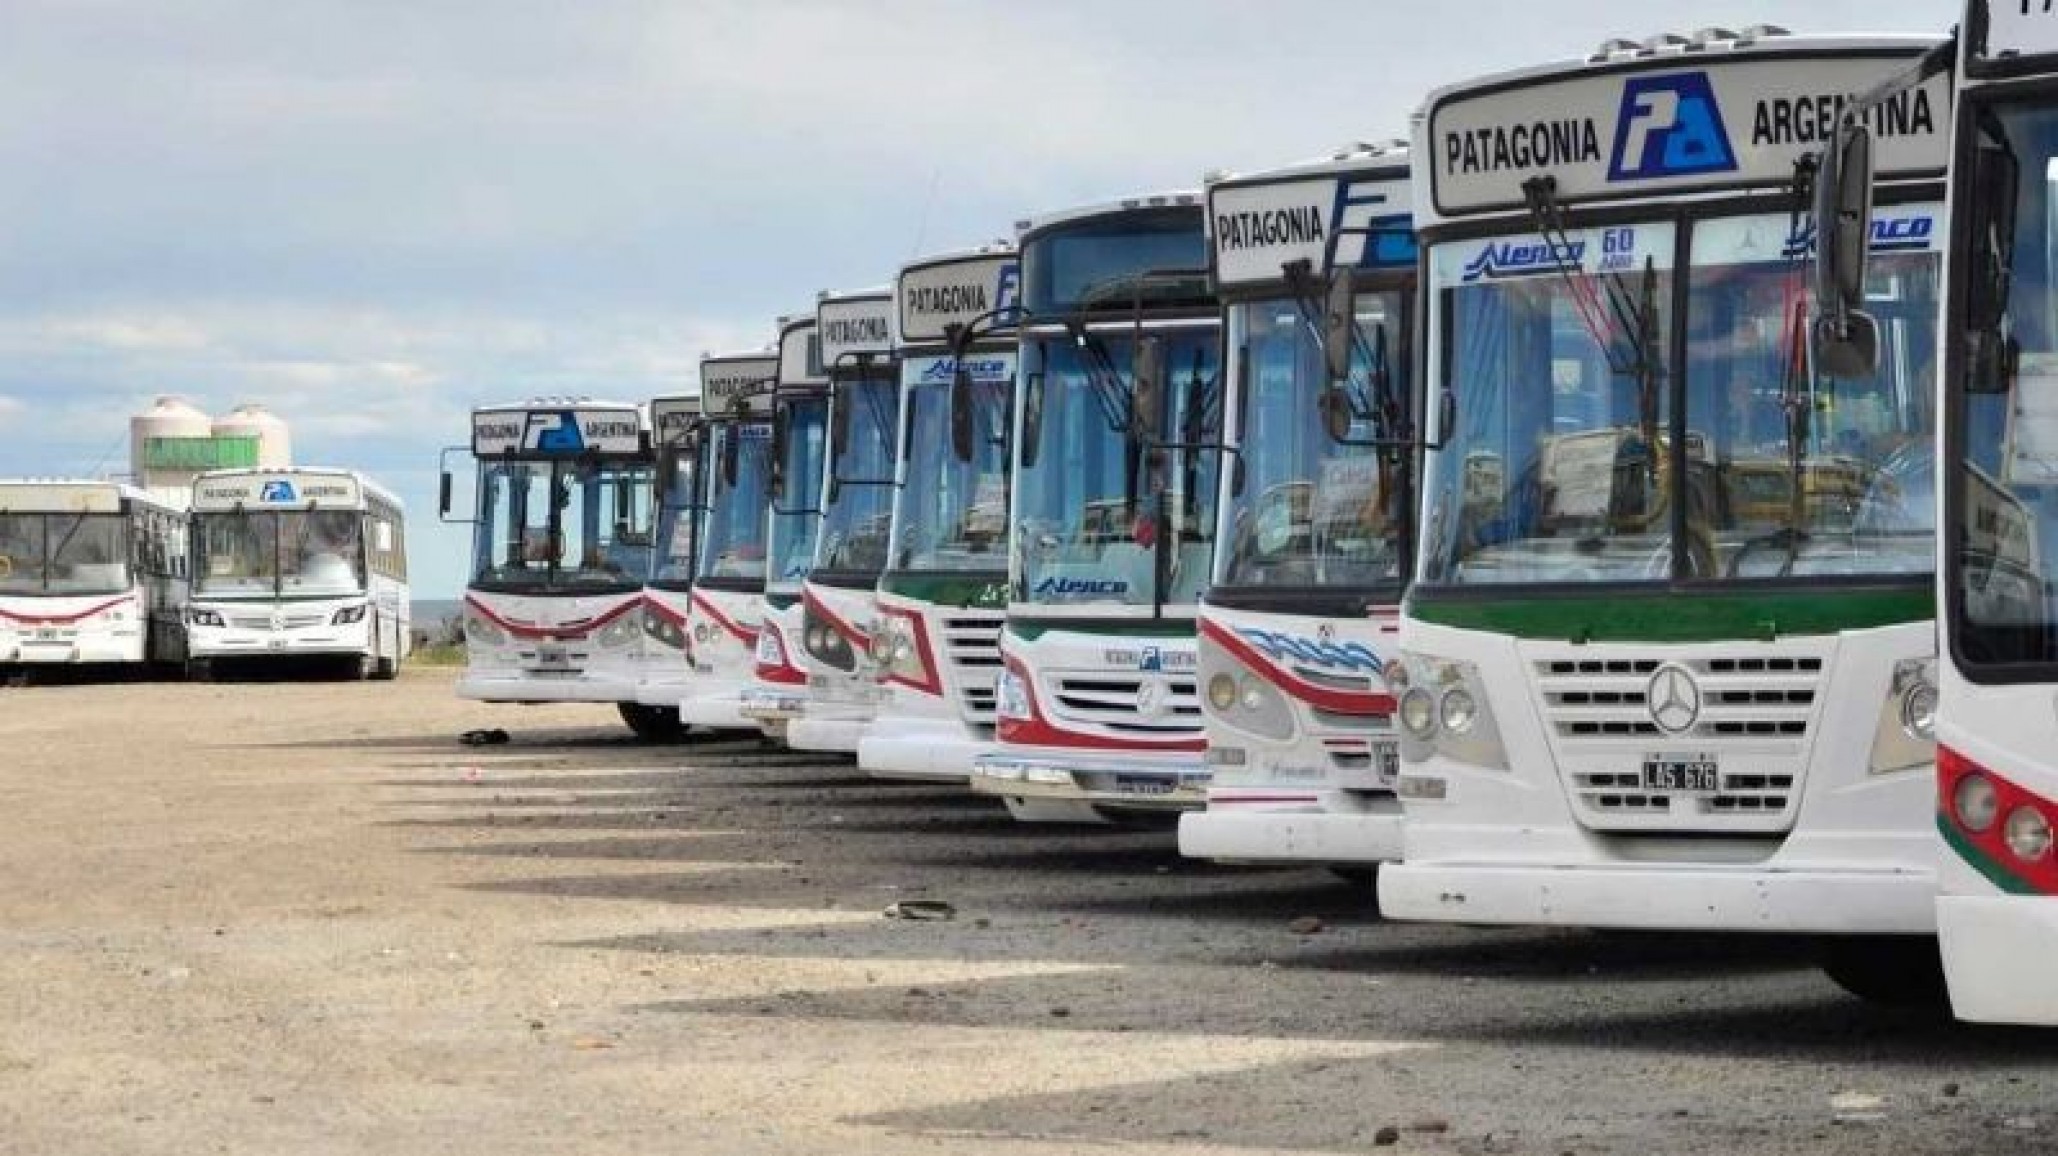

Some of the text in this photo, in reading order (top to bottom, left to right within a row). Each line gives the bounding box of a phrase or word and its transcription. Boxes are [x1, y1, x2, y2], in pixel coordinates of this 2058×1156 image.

[1446, 117, 1601, 175] PATAGONIA
[1752, 89, 1934, 145] ARGEINA
[1218, 205, 1324, 253] PATAGONIA
[907, 284, 986, 314] PATAGONIA
